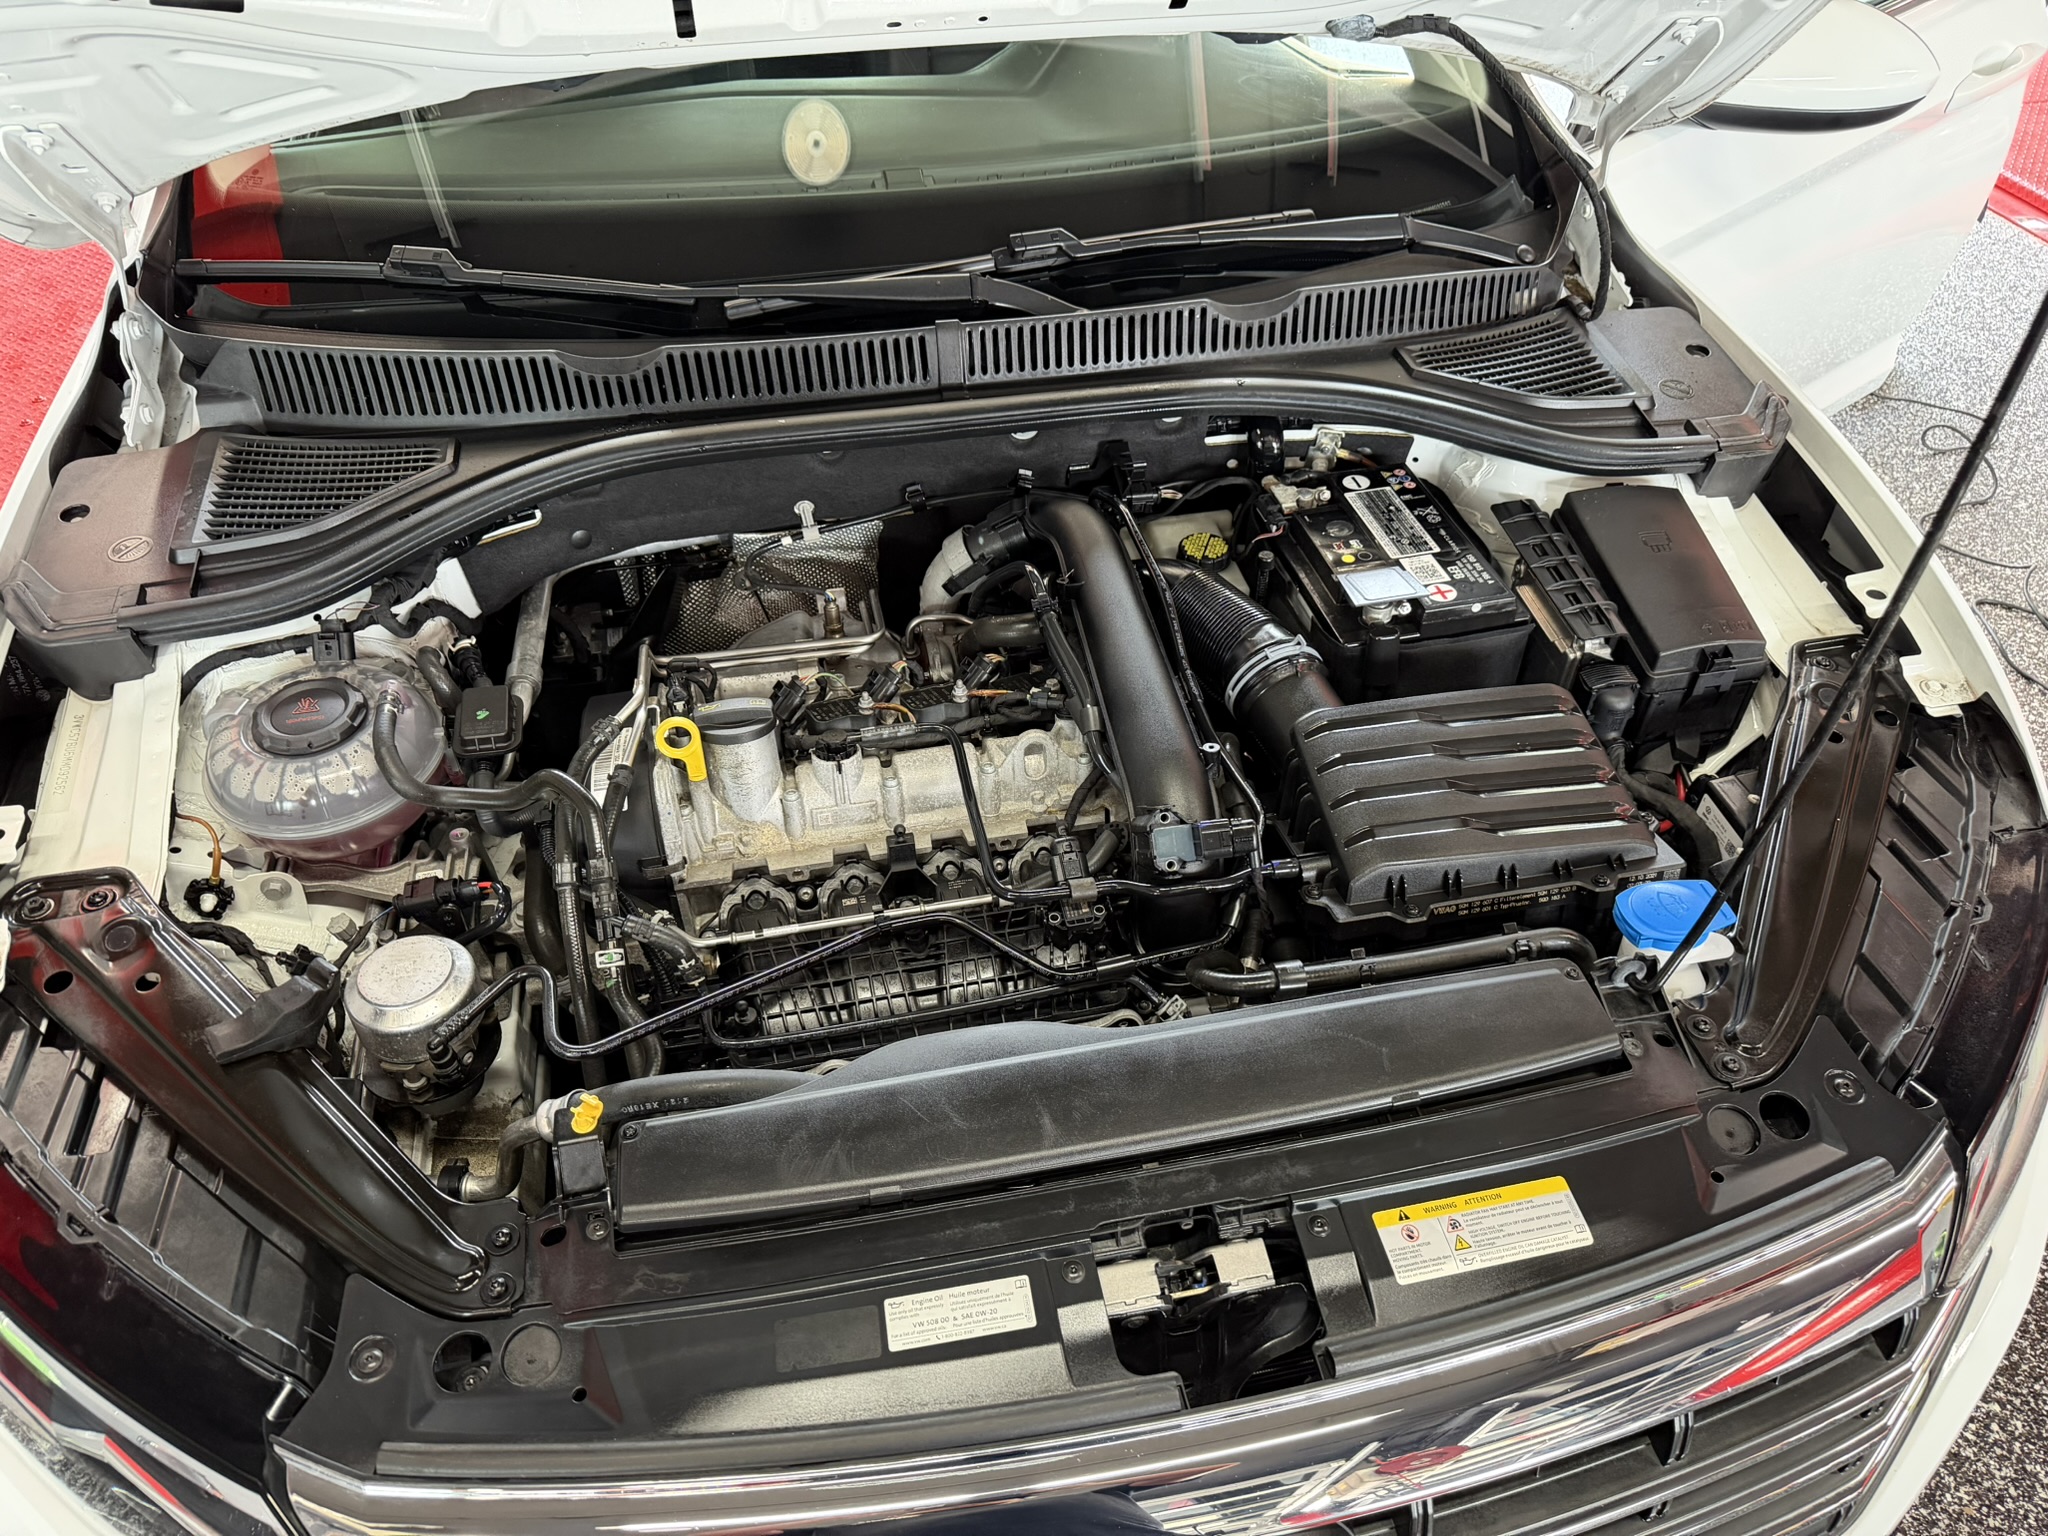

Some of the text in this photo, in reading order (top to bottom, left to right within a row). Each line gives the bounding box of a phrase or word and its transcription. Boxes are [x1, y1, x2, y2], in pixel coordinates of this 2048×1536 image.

[1447, 566, 1465, 579] EFB
[1422, 1193, 1502, 1213] WARNING ATTENTION
[1477, 1249, 1502, 1257] OVERFILLED
[1480, 1254, 1505, 1263] Remplissage
[1534, 1243, 1555, 1251] dangereux
[1394, 1261, 1419, 1269] Composants
[1401, 1264, 1431, 1273] compartiment
[911, 1296, 932, 1307] Engine
[948, 1291, 965, 1299] Huile
[966, 1287, 989, 1296] moteur
[967, 1295, 993, 1303] uniquement
[912, 1320, 924, 1328] VW
[975, 1308, 997, 1317] 0W-20
[916, 1326, 936, 1334] approved
[902, 1337, 930, 1345] www.vw.com
